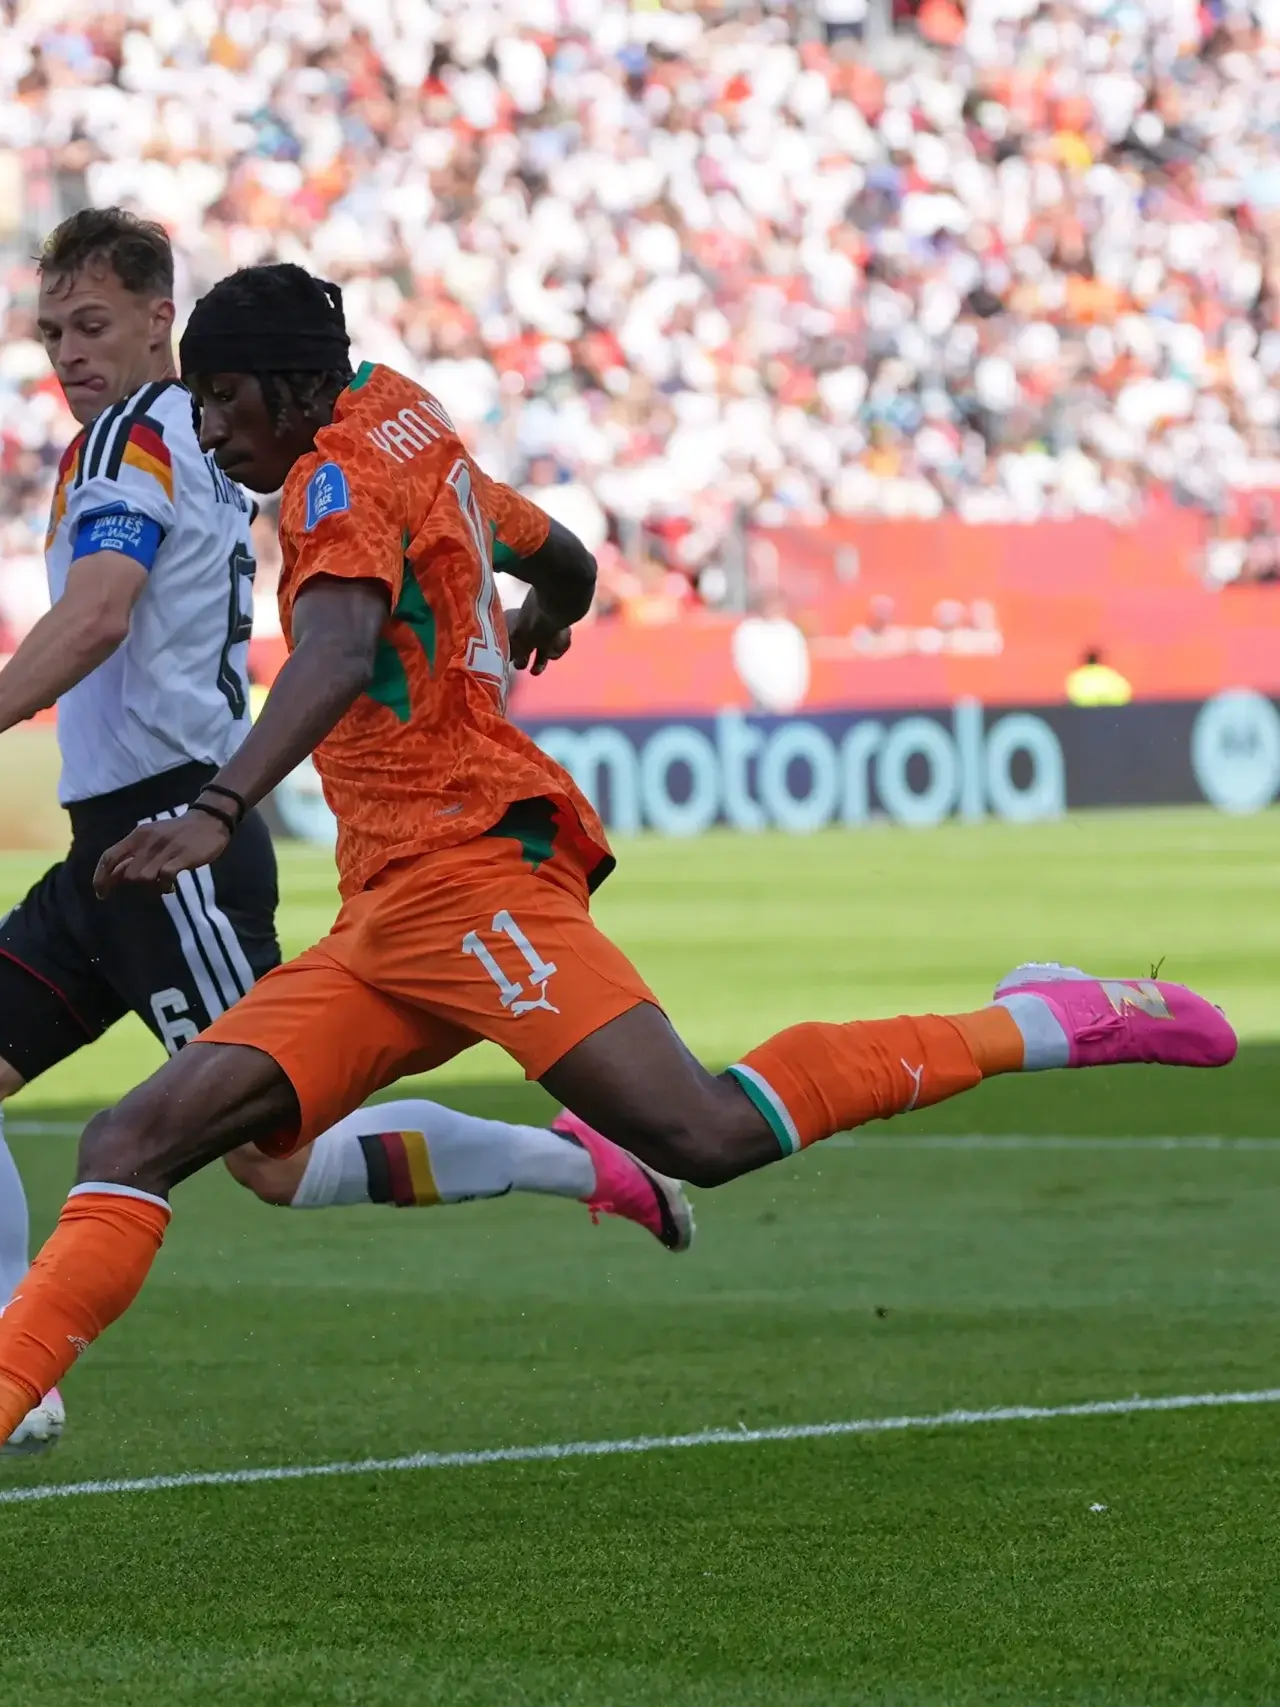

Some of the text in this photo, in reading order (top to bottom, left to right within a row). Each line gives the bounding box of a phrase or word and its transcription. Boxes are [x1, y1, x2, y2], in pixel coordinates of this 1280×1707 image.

[366, 408, 441, 464] YAN
[94, 515, 144, 534] UNITES
[533, 697, 1068, 838] motorola
[461, 909, 558, 1008] 11
[150, 986, 199, 1054] 6
